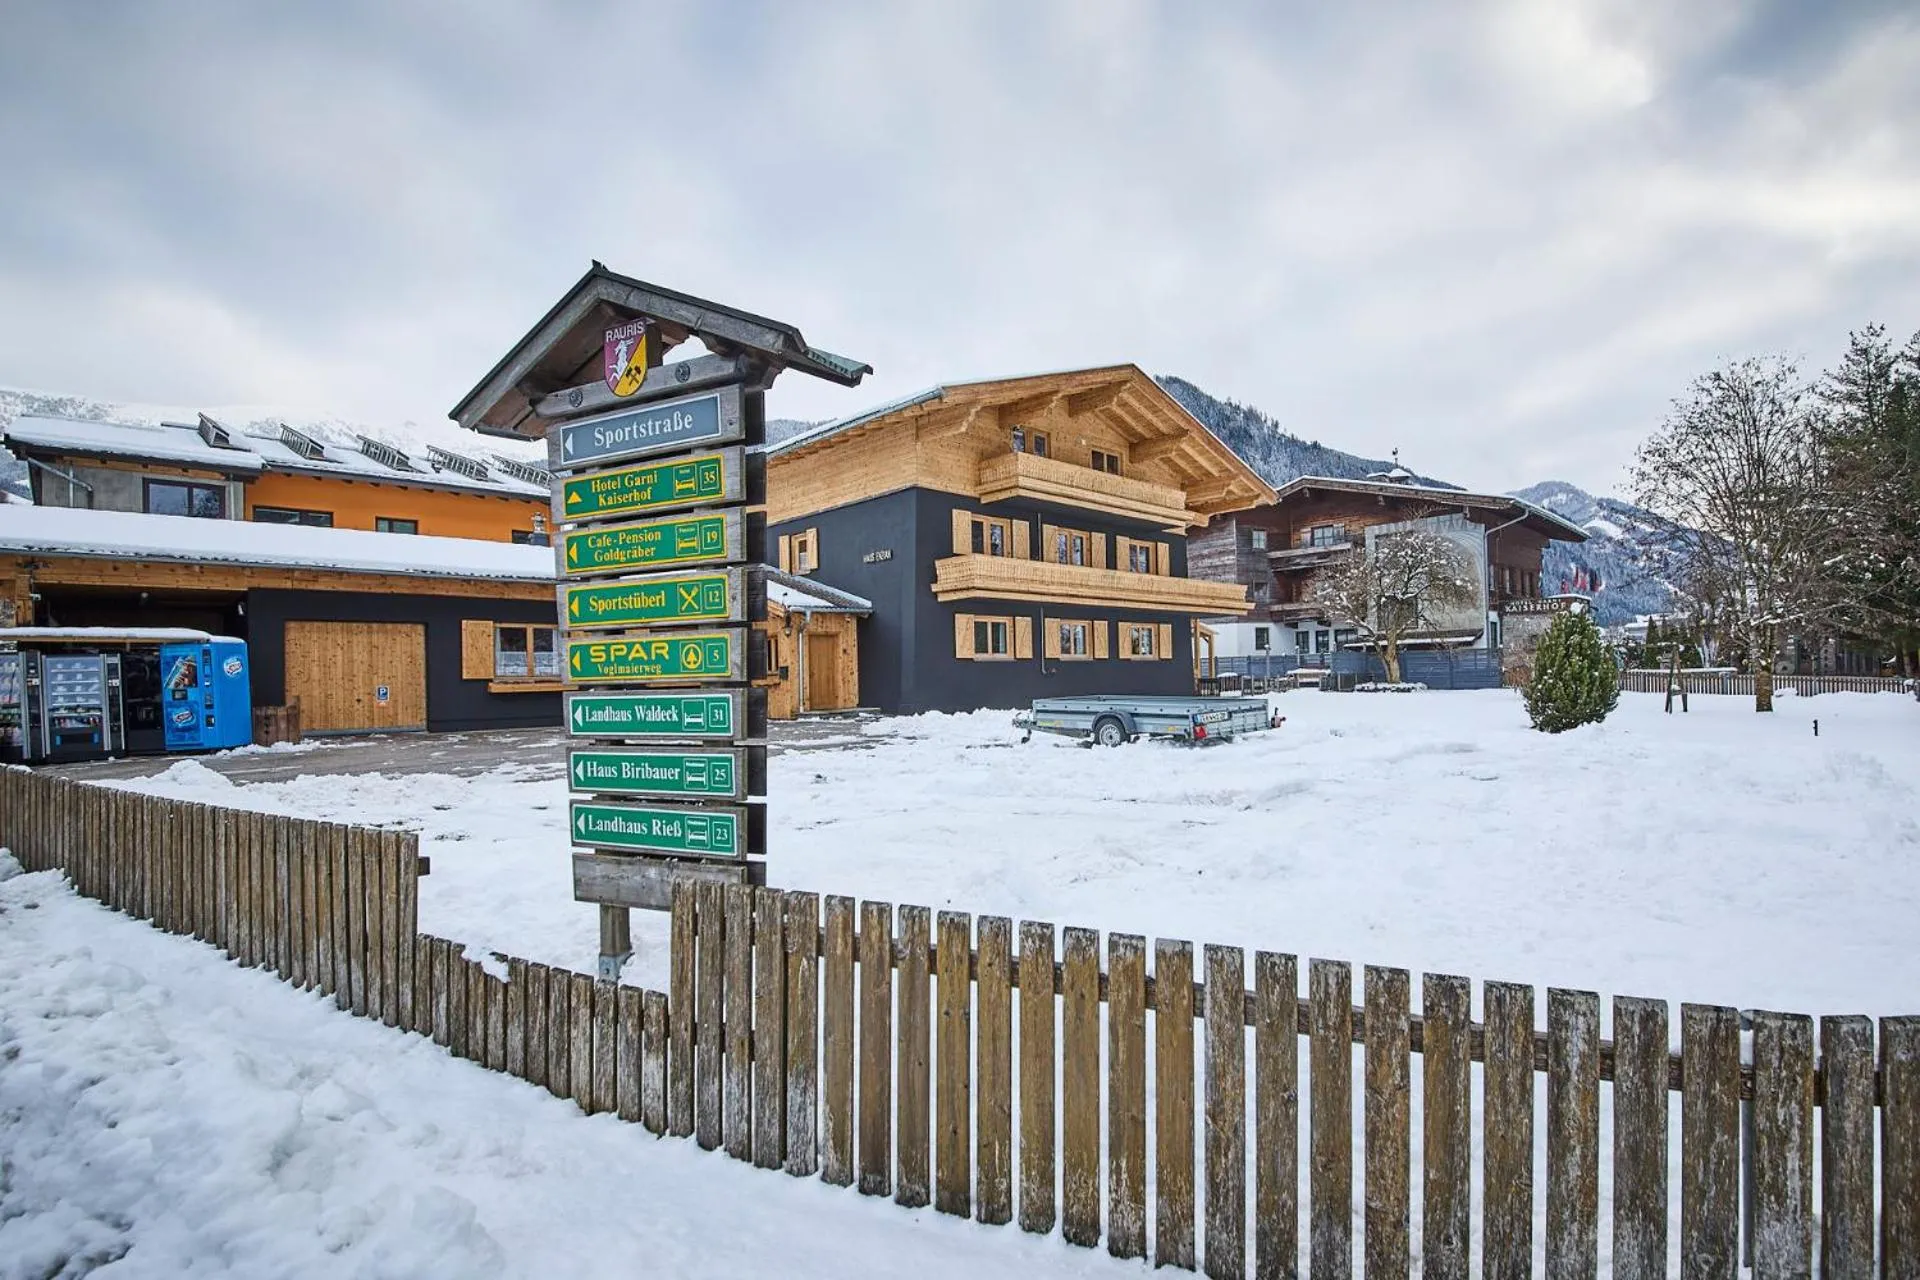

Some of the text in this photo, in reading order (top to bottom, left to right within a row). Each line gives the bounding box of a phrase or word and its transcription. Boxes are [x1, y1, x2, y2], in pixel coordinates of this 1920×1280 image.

[605, 321, 645, 342] RAURIS
[594, 410, 693, 449] Sportstraße
[591, 470, 658, 493] Hotel Garni
[703, 471, 716, 485] 35
[598, 487, 652, 507] Kaiserhof
[706, 531, 718, 543] 19
[594, 545, 656, 562] Goldgräber
[589, 591, 666, 615] Sportstüberl
[708, 591, 720, 602] 12
[1504, 602, 1567, 613] KAISERHOF
[589, 642, 670, 663] SPAR
[712, 650, 720, 662] 5
[597, 662, 662, 676] Voglmaierweg
[585, 704, 679, 722] Landhaus Waldeck
[713, 709, 724, 721] 31
[586, 761, 681, 780] Haus Biribauer
[714, 769, 727, 781] 25
[588, 814, 682, 837] Landhaus Rieß
[716, 828, 728, 840] 23
